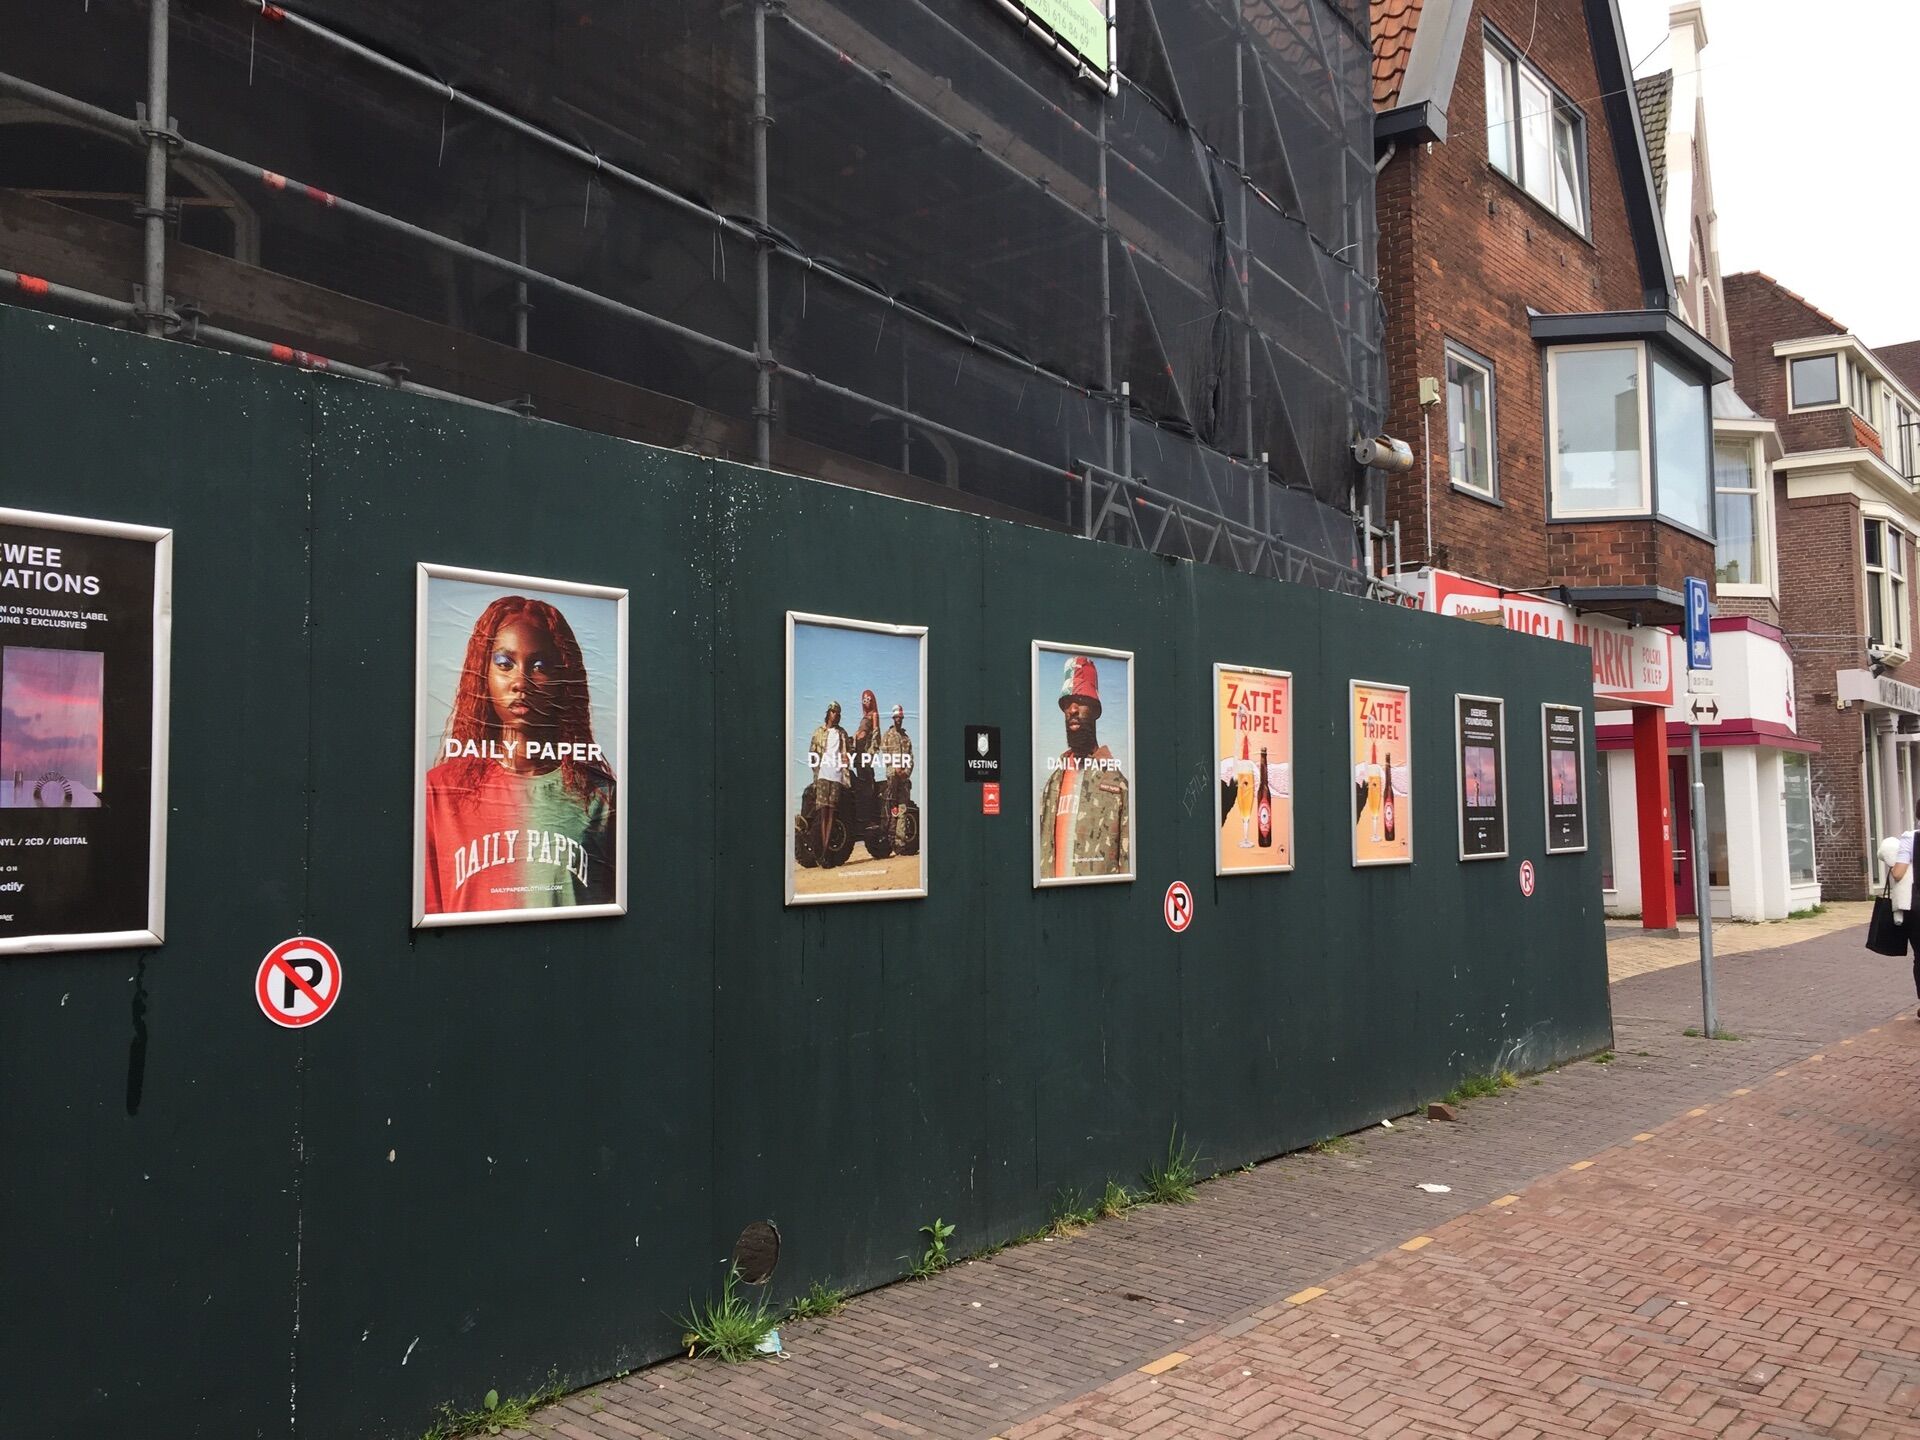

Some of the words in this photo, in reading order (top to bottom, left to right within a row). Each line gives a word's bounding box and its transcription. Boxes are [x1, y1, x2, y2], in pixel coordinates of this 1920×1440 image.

[0, 543, 62, 568] WEE
[0, 568, 100, 595] ATIONS
[9, 606, 24, 615] ON
[26, 607, 79, 619] SOULWAX'S
[81, 612, 109, 621] LABEL
[22, 617, 29, 625] 3
[31, 618, 88, 629] EXCLUSIVES
[1642, 647, 1661, 666] POLSKI
[1643, 667, 1662, 686] SKLEP
[1227, 683, 1282, 715] ZATTE
[1360, 696, 1402, 723] ZATTE
[1231, 712, 1279, 734] TRIPEL
[1362, 722, 1399, 740] TRIPEL
[445, 738, 520, 760] DAILY
[526, 741, 603, 762] PAPER
[808, 752, 857, 768] DAILY
[861, 753, 912, 769] PAPER
[968, 760, 998, 769] VESTING
[1047, 756, 1081, 770] DAILY
[1084, 757, 1122, 771] PAPER
[25, 838, 44, 846] 2CD
[53, 837, 88, 845] DIGITAL
[454, 829, 520, 890] DAILY
[527, 828, 589, 888] PAPER
